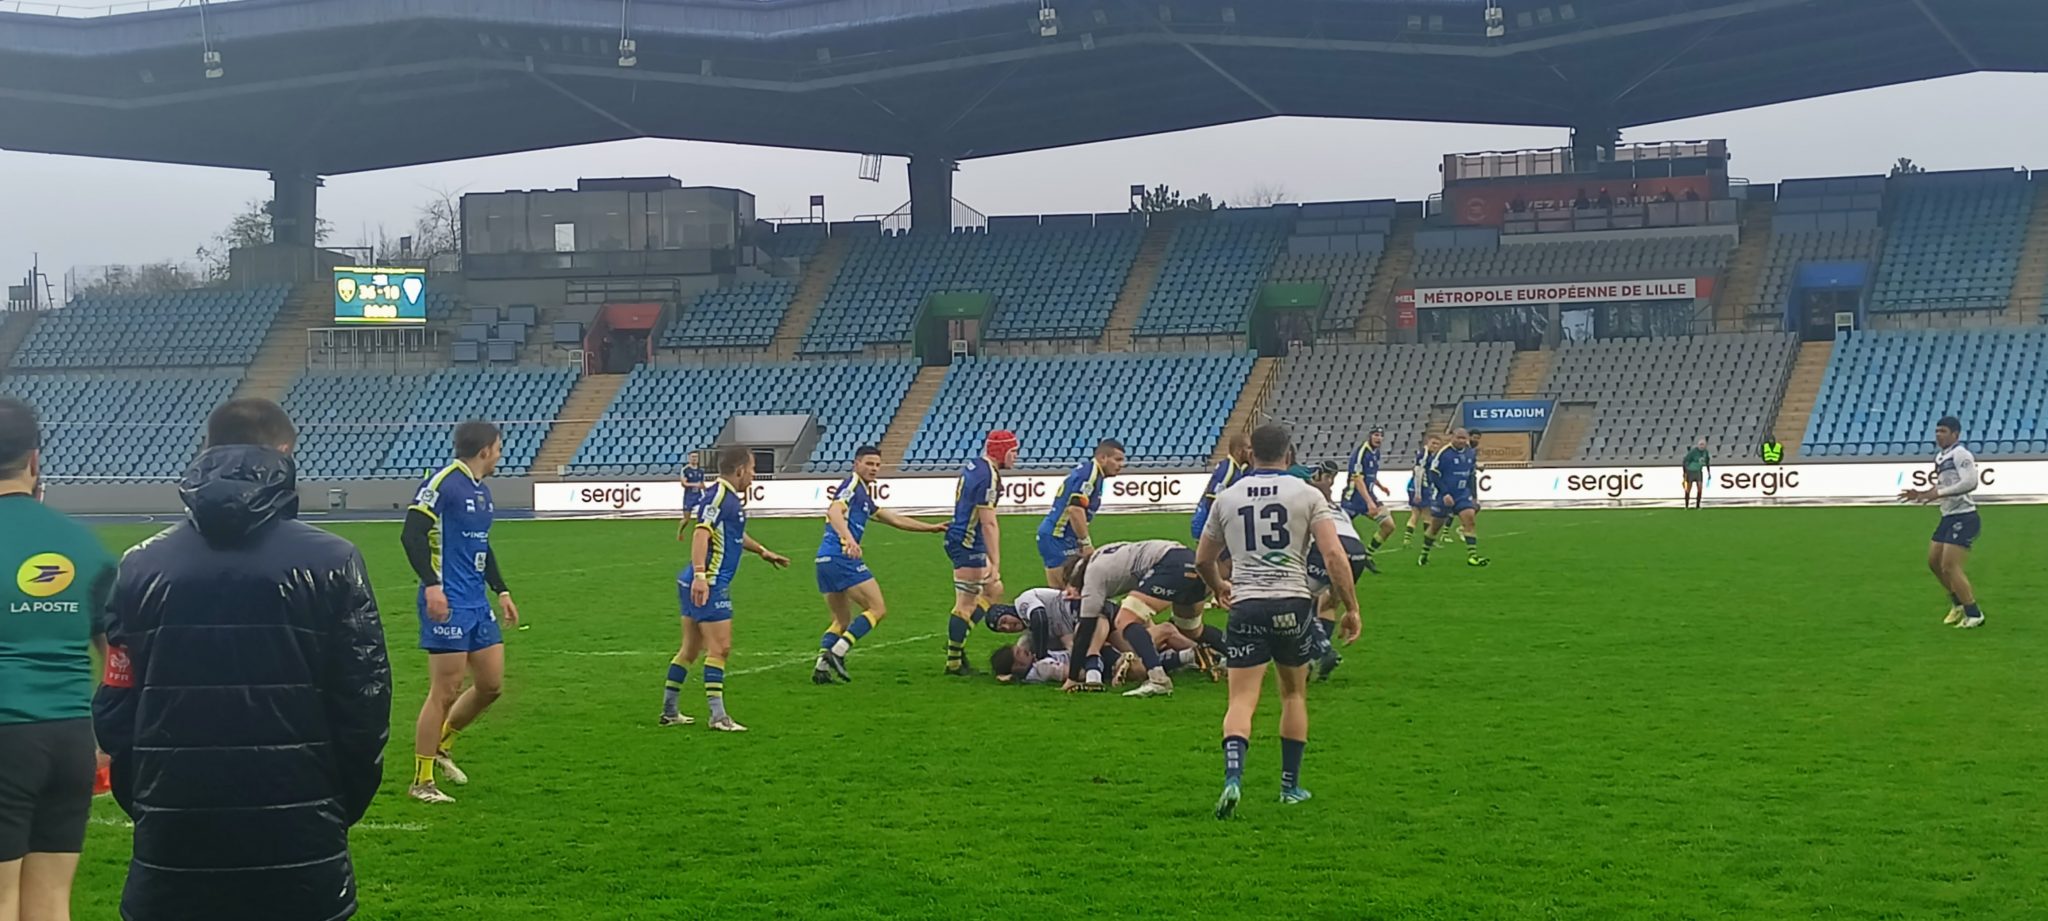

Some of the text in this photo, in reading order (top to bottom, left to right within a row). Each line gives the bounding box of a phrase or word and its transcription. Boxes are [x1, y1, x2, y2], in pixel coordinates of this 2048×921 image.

[1424, 283, 1687, 304] MÉTROPOLE EUROPÉENNE DE LILLE
[1473, 408, 1545, 419] LE STADIUM
[998, 478, 1046, 504] ergic
[1113, 476, 1182, 502] sergic
[1247, 485, 1278, 498] HBI
[1567, 469, 1644, 497] sergic
[1720, 467, 1800, 495] sergic
[581, 483, 641, 509] sergic
[1237, 503, 1291, 552] 13
[10, 602, 79, 613] LA POSTE
[433, 625, 463, 636] SOGEA
